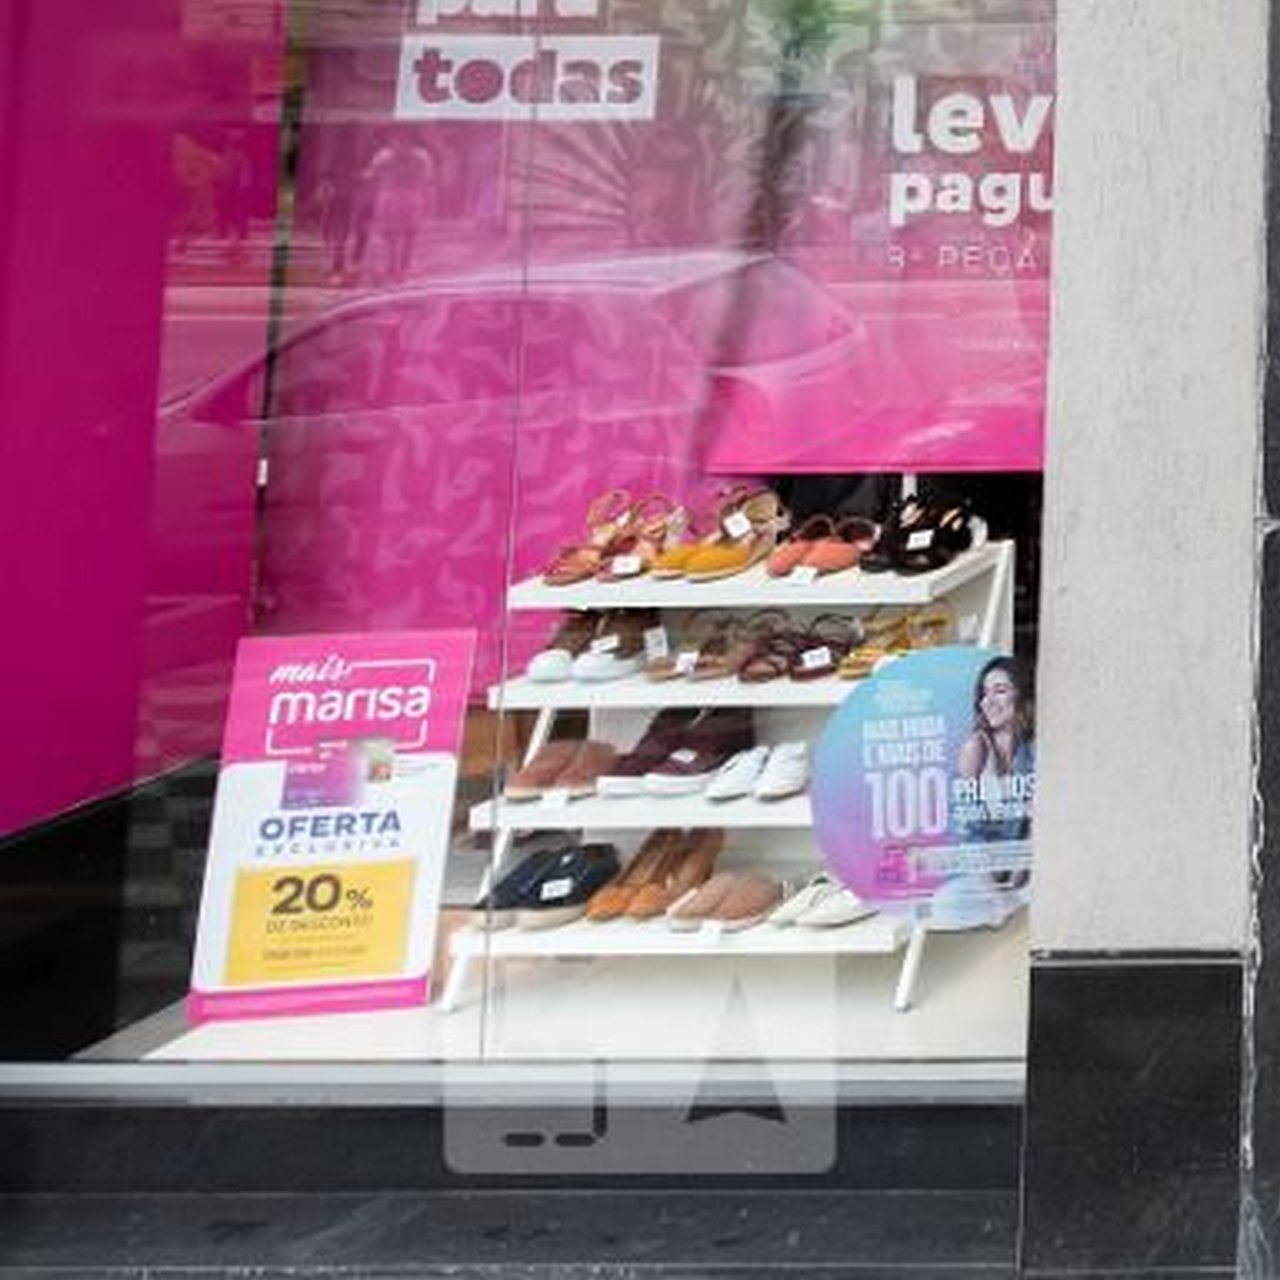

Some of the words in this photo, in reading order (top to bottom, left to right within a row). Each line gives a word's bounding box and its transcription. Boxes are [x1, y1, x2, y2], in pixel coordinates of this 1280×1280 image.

[413, 47, 644, 104] todas
[268, 685, 431, 724] marisa
[259, 809, 402, 841] OFERTA
[863, 768, 949, 839] 100
